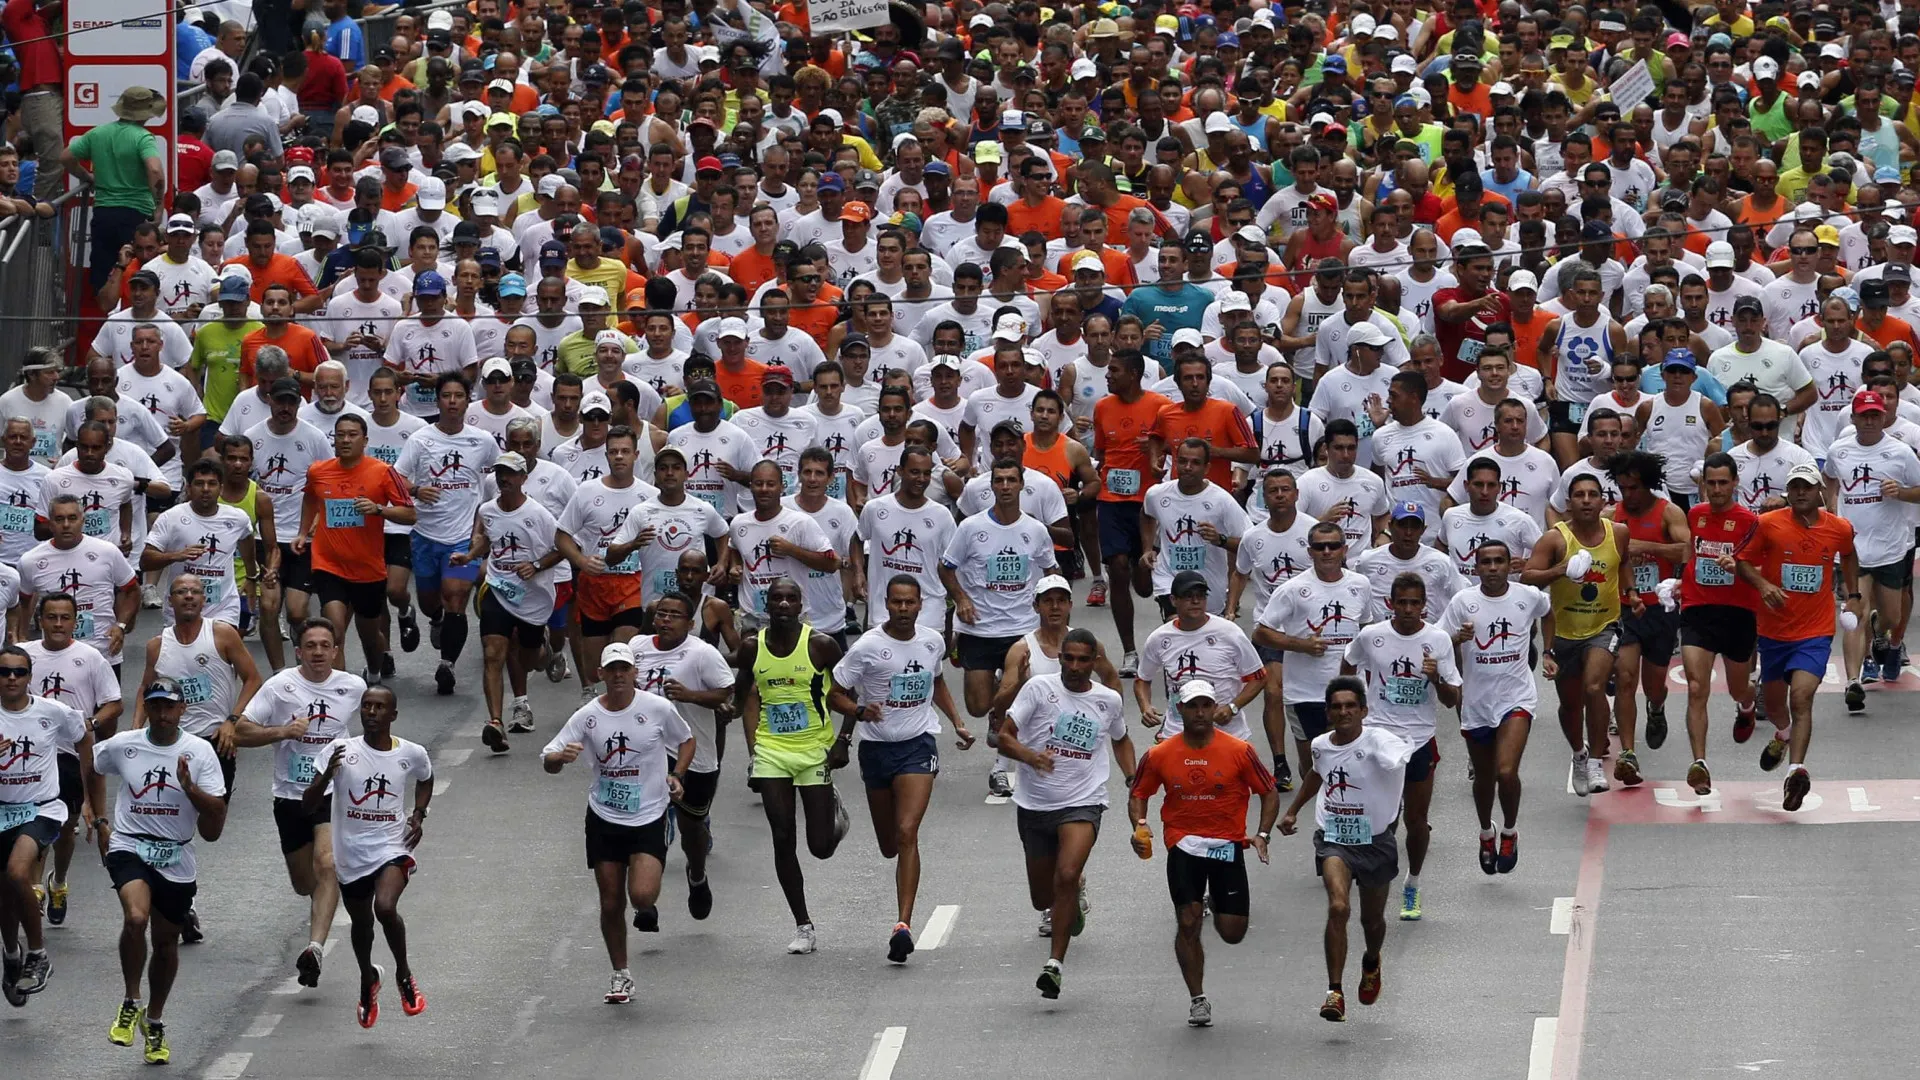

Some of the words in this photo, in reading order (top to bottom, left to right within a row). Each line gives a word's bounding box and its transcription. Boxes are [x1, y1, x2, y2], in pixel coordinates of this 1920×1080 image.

[811, 8, 837, 24] SÃO
[77, 85, 95, 102] G
[1113, 476, 1132, 485] 1553
[5, 513, 28, 523] 1666
[85, 517, 103, 528] 506
[1175, 552, 1199, 562] 1631
[894, 562, 923, 573] SILVESTRE
[996, 562, 1021, 572] 1619
[1790, 573, 1816, 582] 1612
[999, 583, 1026, 591] SILVESTRE
[1476, 656, 1488, 664] SÃO
[1489, 654, 1520, 664] SILVESTRE
[184, 684, 202, 695] 501
[901, 680, 926, 691] 1562
[1397, 685, 1422, 695] 1696
[185, 696, 205, 704] AIXA
[885, 699, 898, 708] SÃO
[899, 698, 926, 708] SILVESTRE
[773, 710, 802, 724] 23931
[777, 724, 802, 733] CAIXA
[1067, 719, 1093, 738] 1585
[1062, 735, 1087, 748] CAIXA
[1060, 749, 1092, 760] SILVESTRE
[297, 763, 317, 774] 156
[9, 775, 42, 785] SILVESTRE
[607, 788, 632, 801] 1657
[130, 806, 142, 814] SÃO
[143, 807, 179, 816] SILVESTRE
[604, 801, 629, 811] CAIXA
[347, 810, 361, 819] SÃO
[362, 813, 396, 822] SILVESTRE
[1335, 825, 1361, 834] 1671
[147, 847, 173, 858] 1709
[1207, 847, 1228, 860] 705
